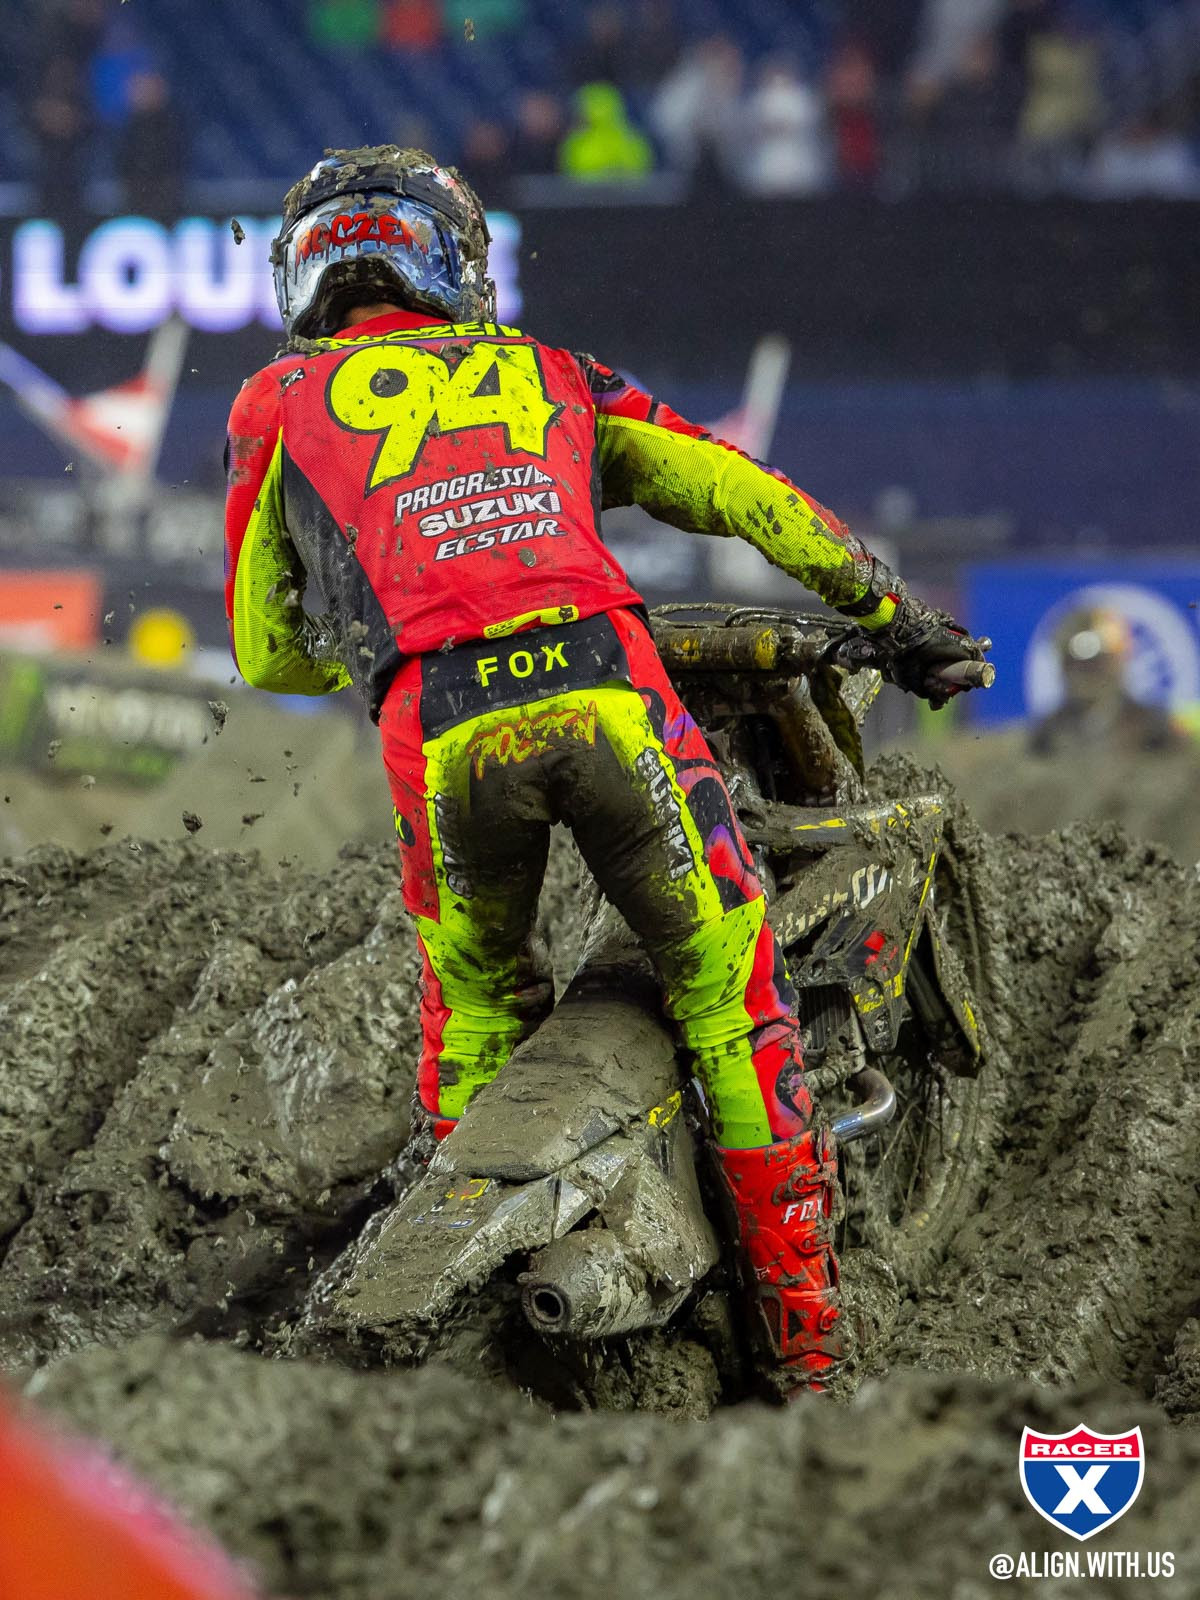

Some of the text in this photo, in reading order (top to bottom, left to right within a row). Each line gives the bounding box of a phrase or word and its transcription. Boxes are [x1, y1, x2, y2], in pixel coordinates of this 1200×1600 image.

[326, 341, 564, 497] 94
[419, 491, 562, 537] SUZUKI
[434, 519, 567, 561] ECSTAR
[477, 642, 569, 688] FOX
